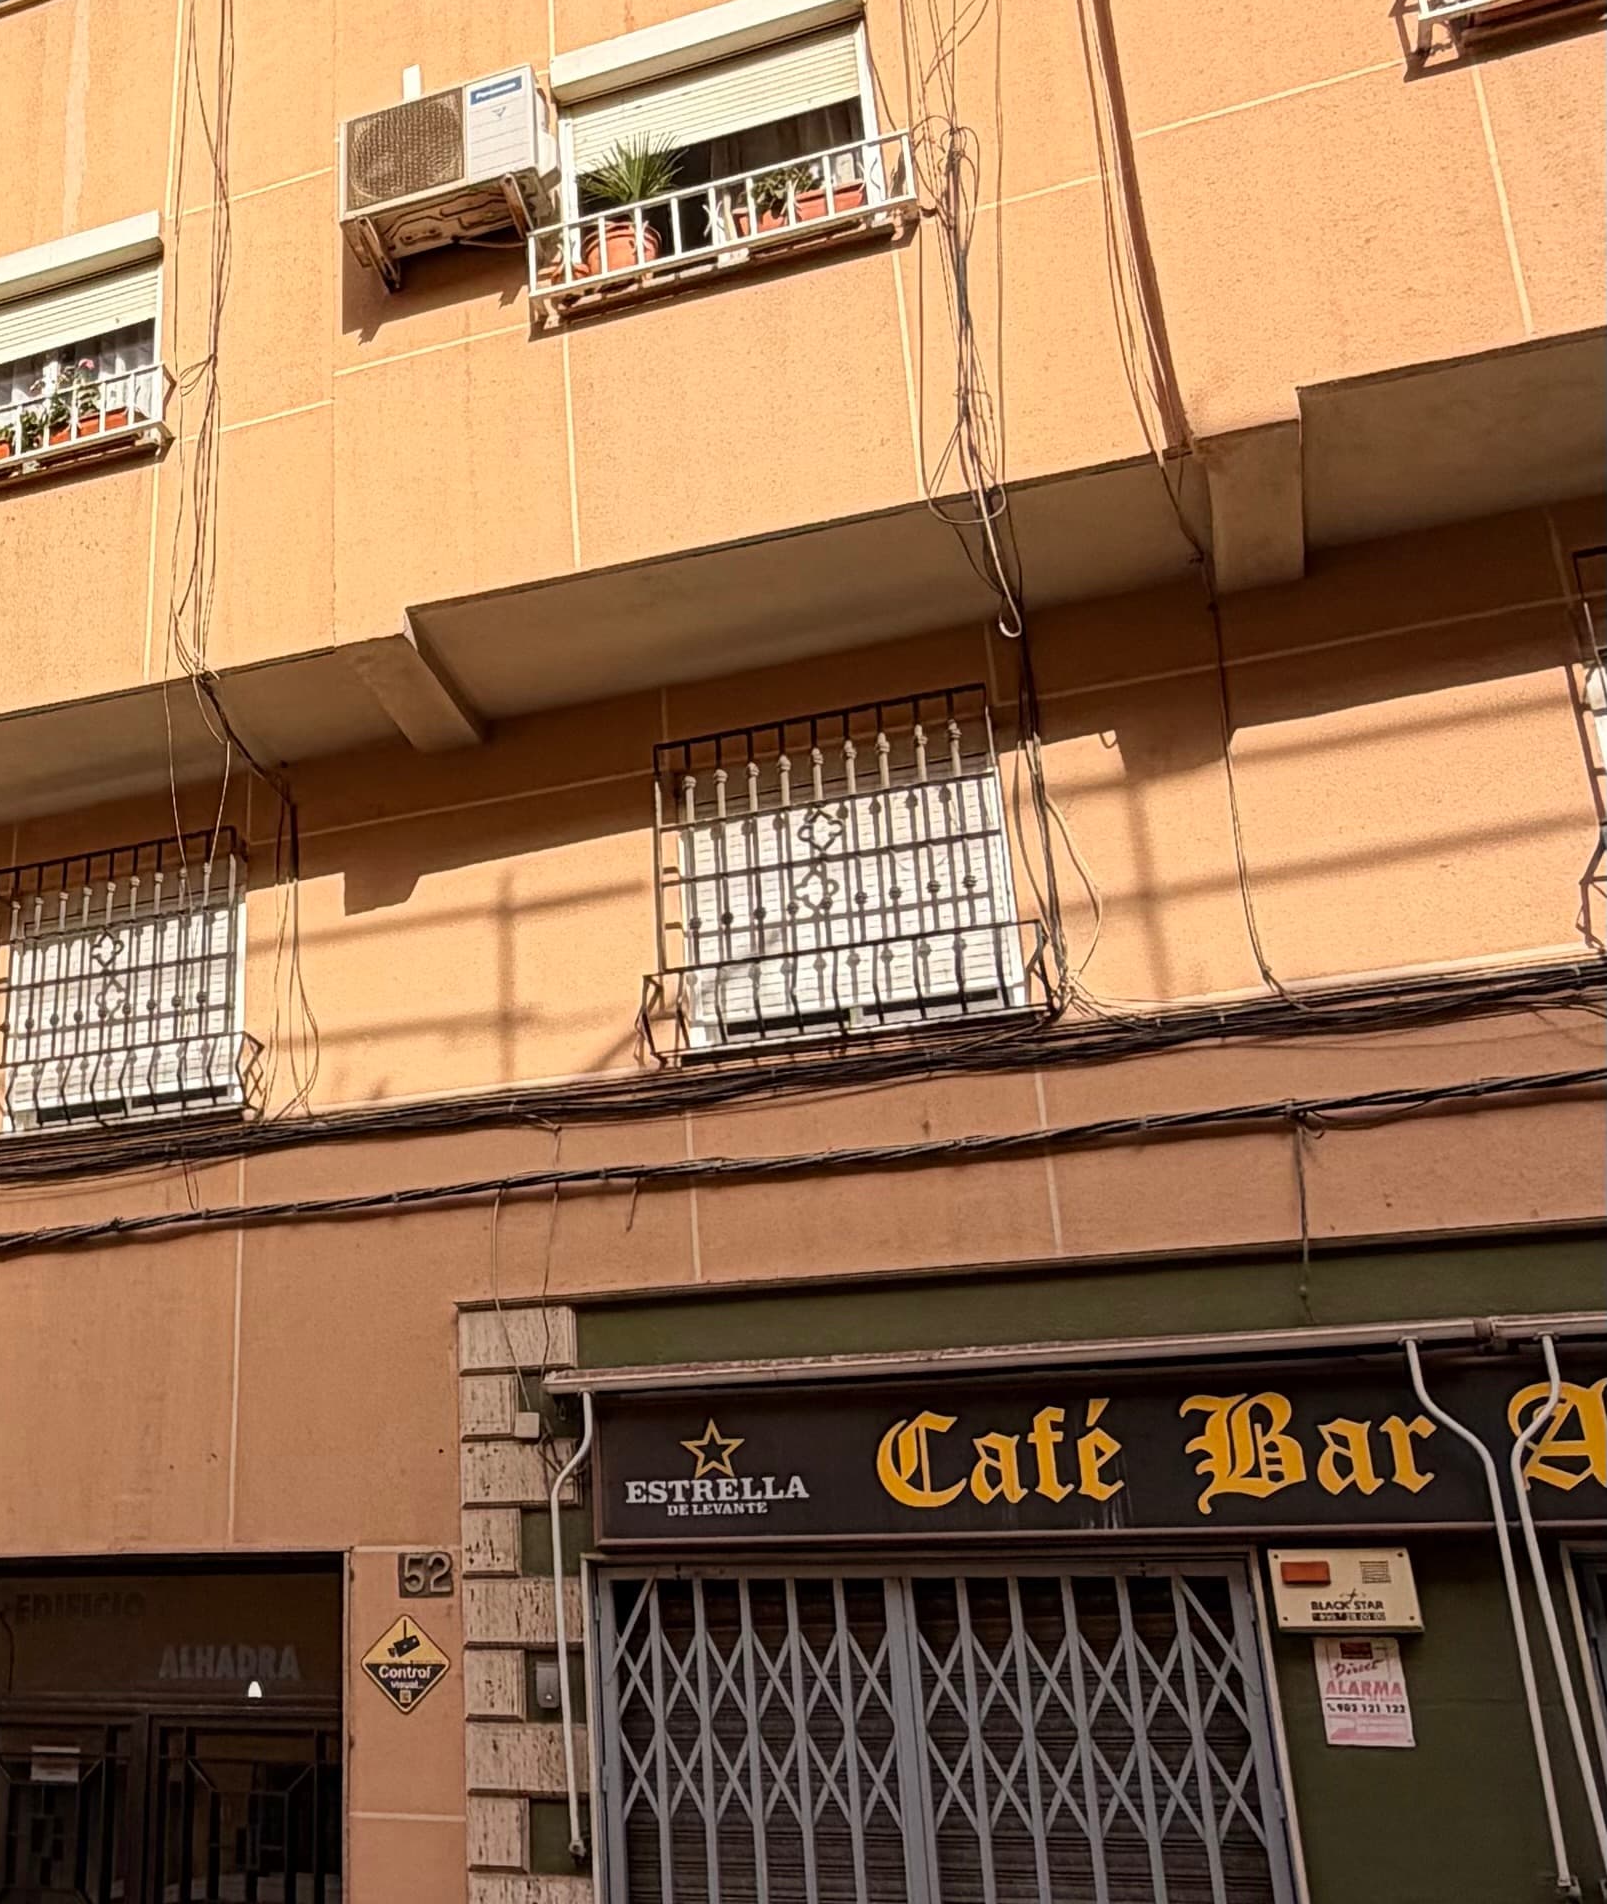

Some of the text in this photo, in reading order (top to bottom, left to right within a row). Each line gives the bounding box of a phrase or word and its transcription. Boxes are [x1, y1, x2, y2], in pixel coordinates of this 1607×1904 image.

[876, 1398, 1124, 1508] Café
[1179, 1392, 1437, 1515] Bar
[624, 1475, 810, 1504] ESTRELLA
[667, 1500, 769, 1517] DE LEVANTE
[404, 1552, 453, 1594] 52
[1311, 1599, 1384, 1611] BLACK STAR
[158, 1645, 301, 1681] ALHADRA
[378, 1665, 432, 1679] Control
[1325, 1681, 1403, 1698] ALARMA
